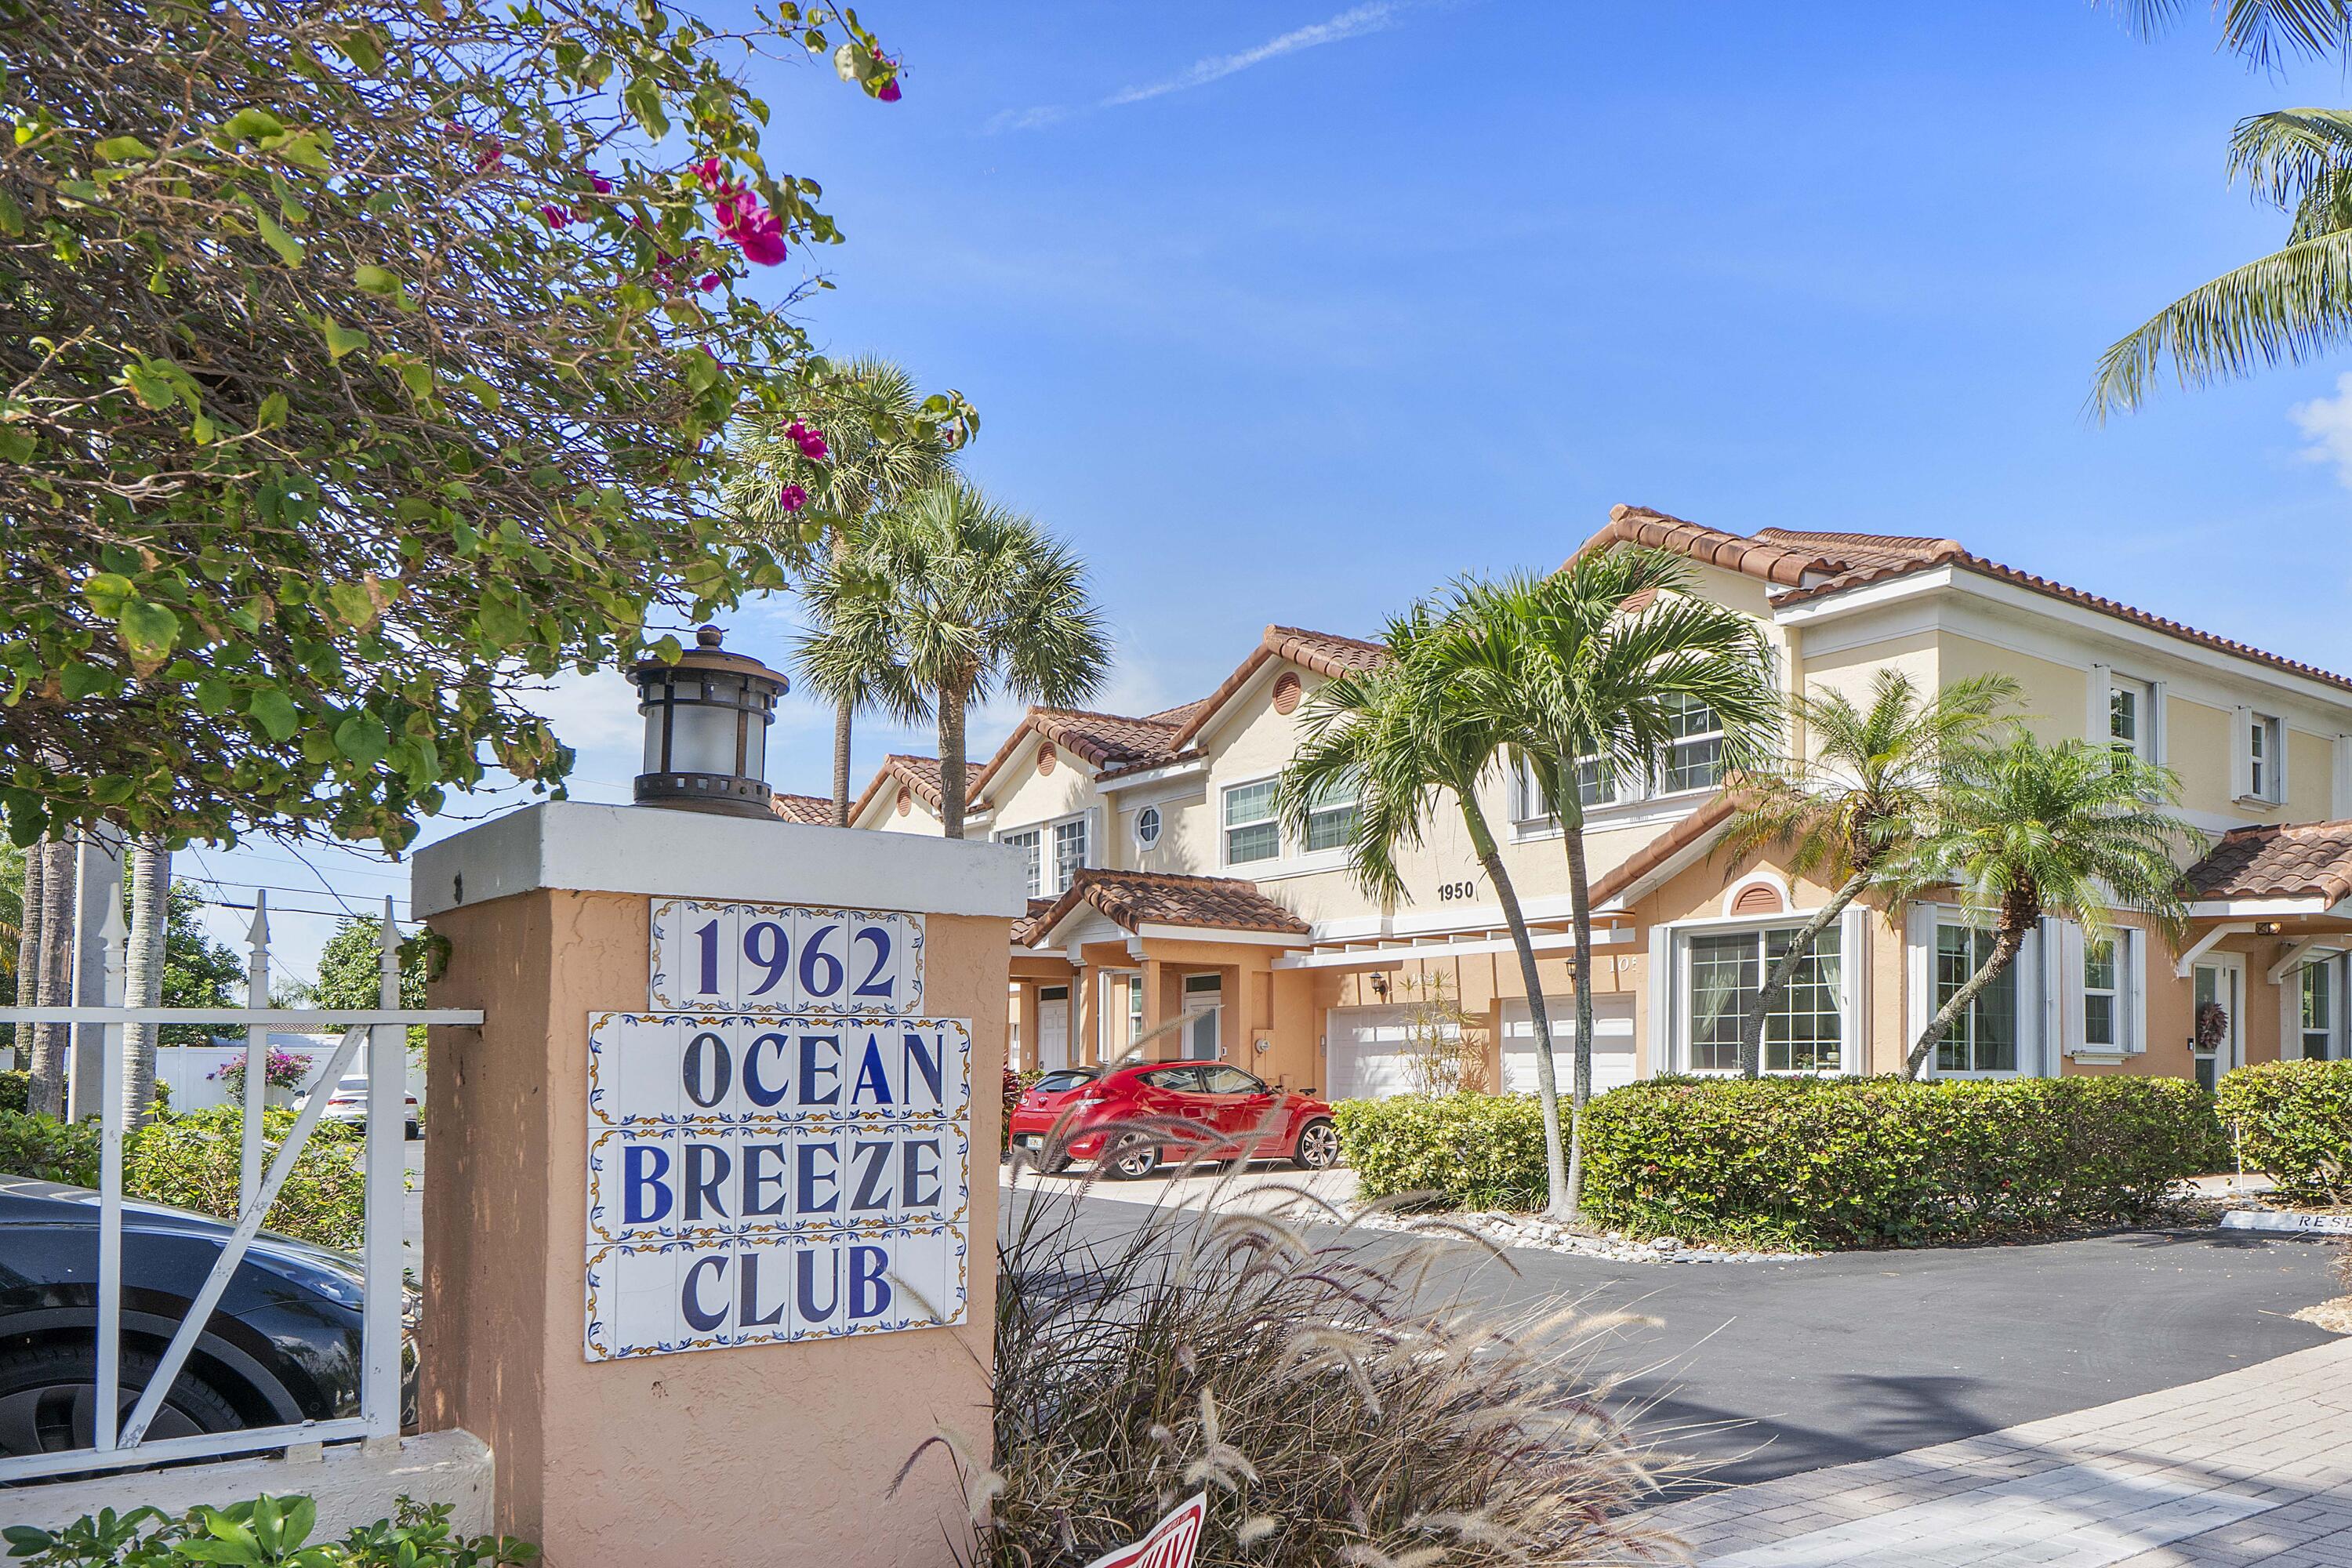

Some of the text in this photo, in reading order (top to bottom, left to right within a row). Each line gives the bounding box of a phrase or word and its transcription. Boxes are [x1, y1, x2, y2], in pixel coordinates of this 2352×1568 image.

[1438, 881, 1473, 901] 1950
[695, 919, 896, 998] 1962
[682, 1032, 944, 1108] OCEAN
[622, 1138, 942, 1225] BREEZE
[681, 1245, 893, 1332] CLUB
